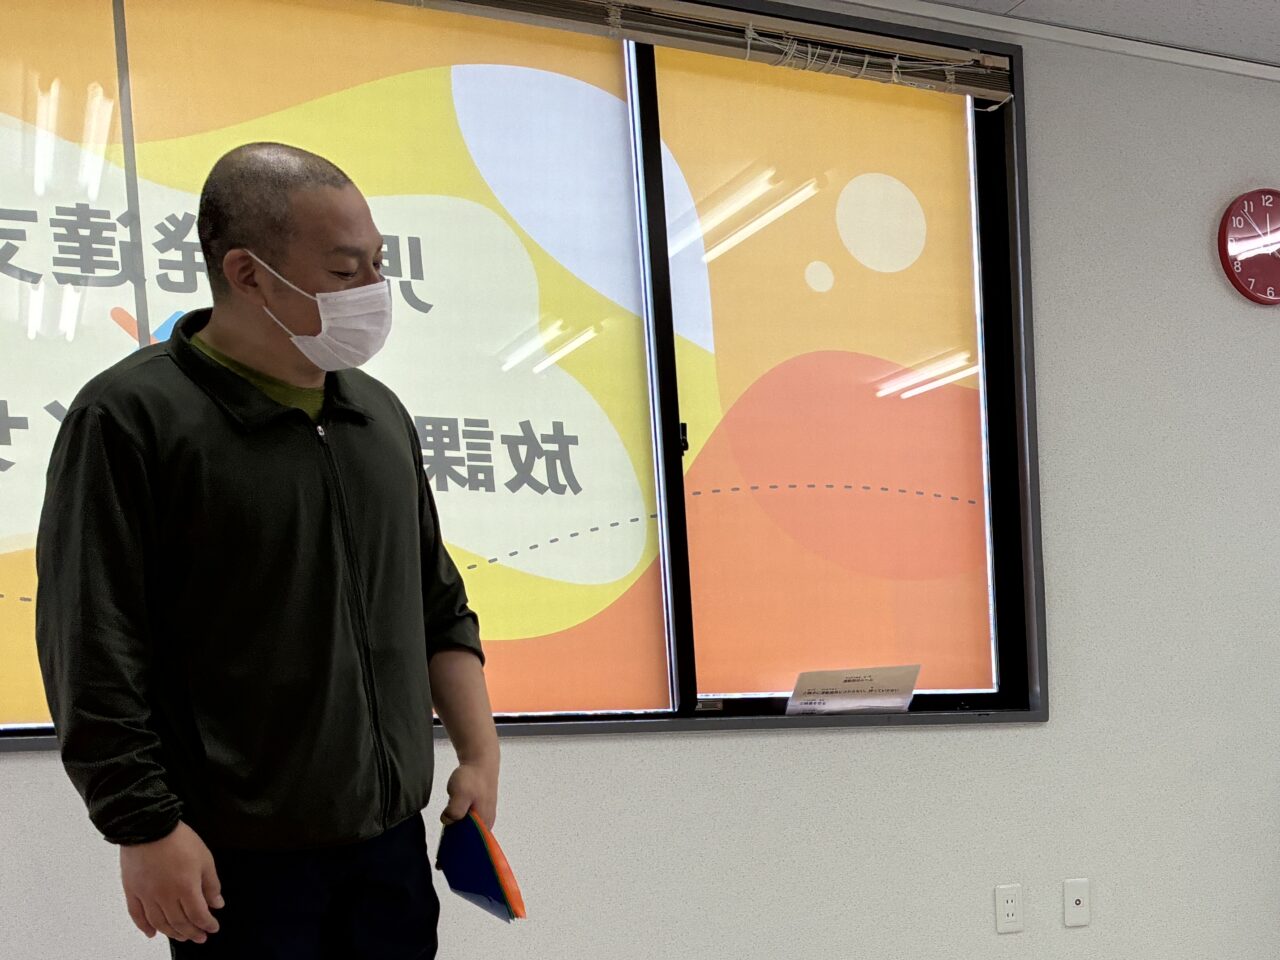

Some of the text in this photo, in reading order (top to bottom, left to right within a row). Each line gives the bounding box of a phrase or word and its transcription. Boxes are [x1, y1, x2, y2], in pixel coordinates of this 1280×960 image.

[1243, 200, 1254, 213] 11
[1261, 194, 1274, 207] 12
[1231, 216, 1244, 229] 10
[1234, 261, 1242, 272] 8
[1248, 279, 1255, 290] 7
[1267, 287, 1275, 297] 6
